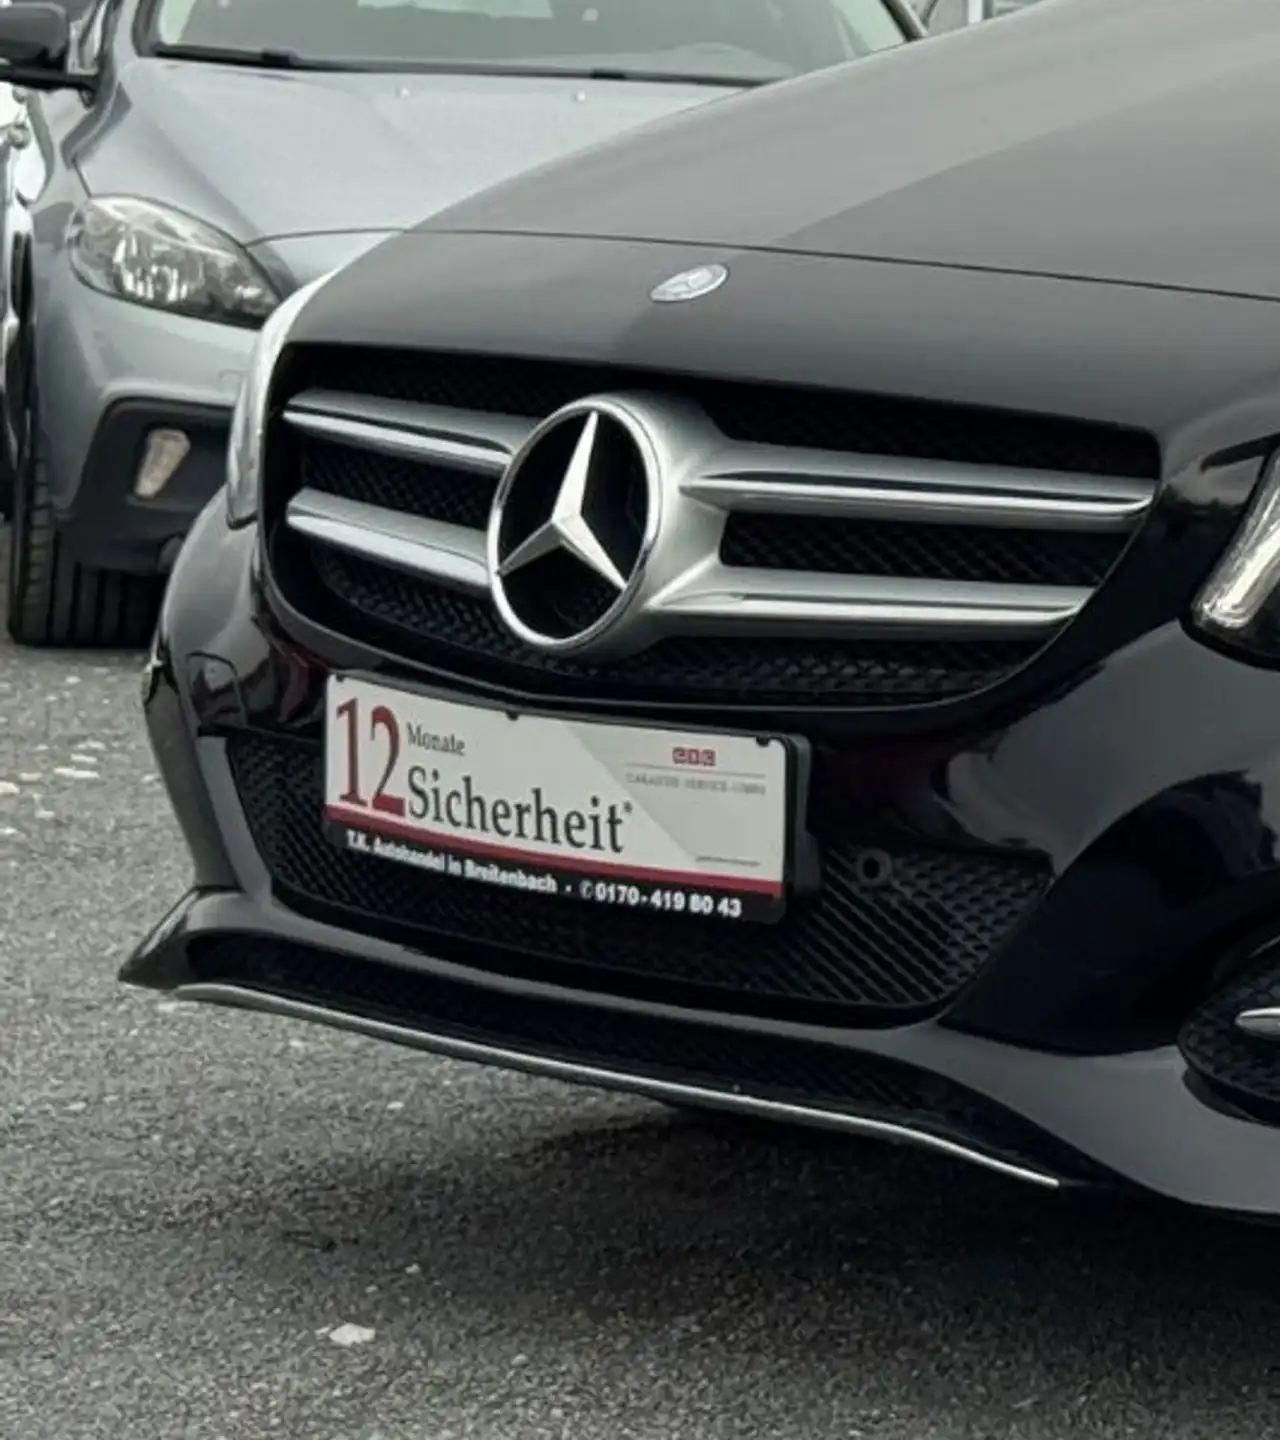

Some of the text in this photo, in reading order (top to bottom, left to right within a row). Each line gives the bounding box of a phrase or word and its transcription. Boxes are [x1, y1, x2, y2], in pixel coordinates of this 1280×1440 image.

[336, 696, 406, 817] 12
[406, 721, 466, 757] Monate
[447, 853, 463, 877] in
[464, 858, 558, 894] Breitenbach
[717, 897, 742, 918] 43
